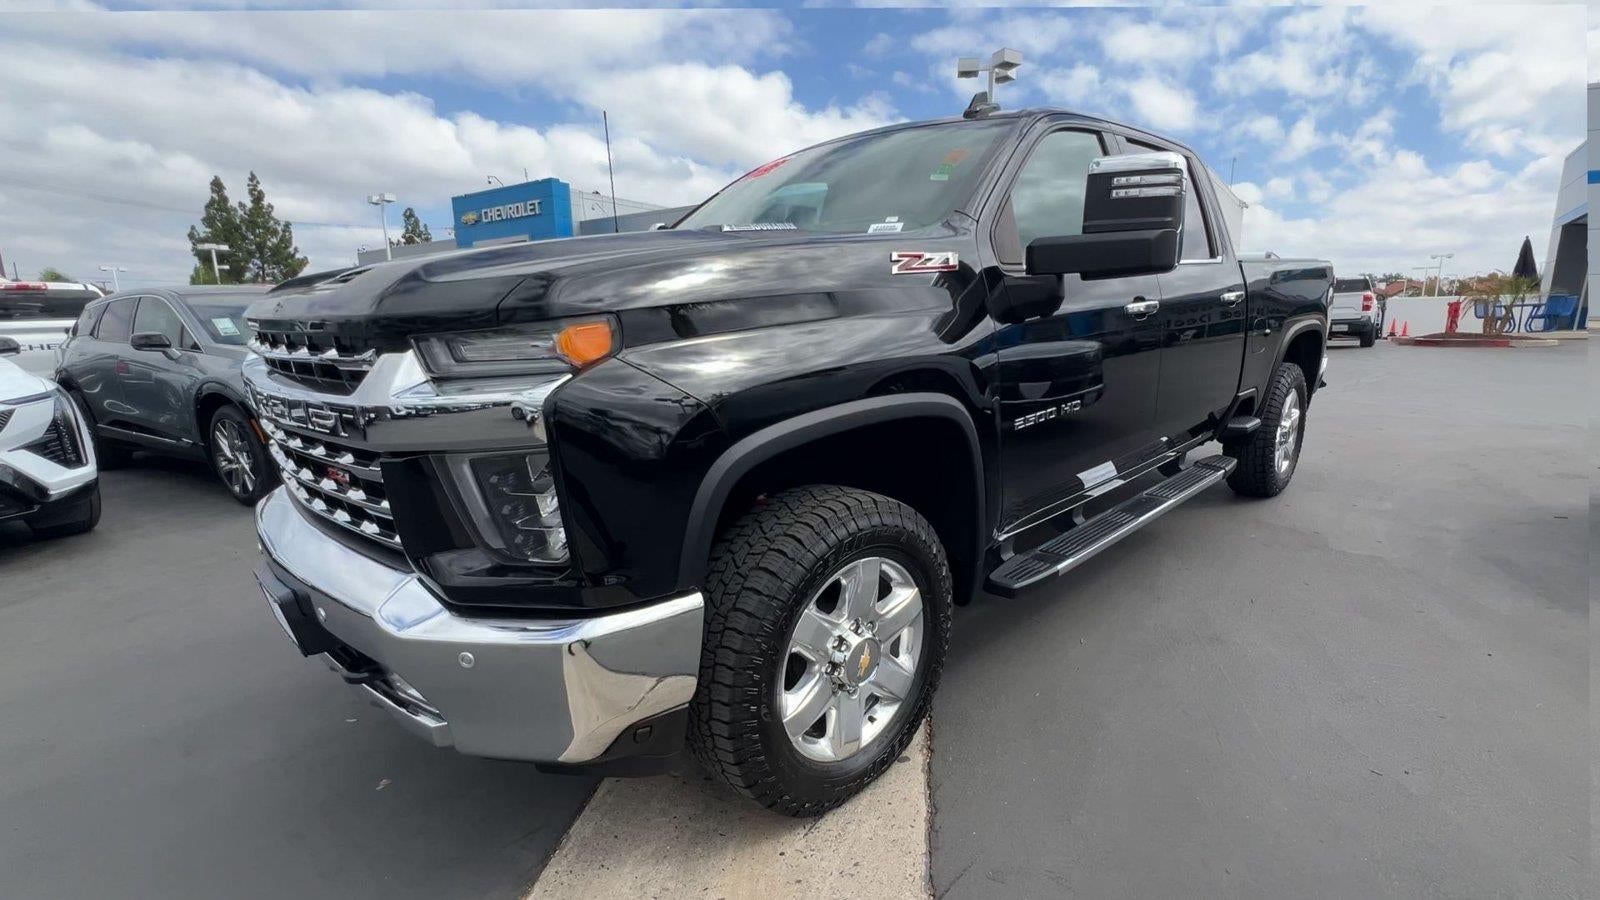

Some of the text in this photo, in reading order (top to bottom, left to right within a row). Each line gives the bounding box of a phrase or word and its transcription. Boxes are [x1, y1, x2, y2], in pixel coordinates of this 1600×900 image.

[481, 200, 541, 222] CHEVROLET
[890, 252, 959, 274] Z71
[1014, 400, 1081, 430] 2500 HD
